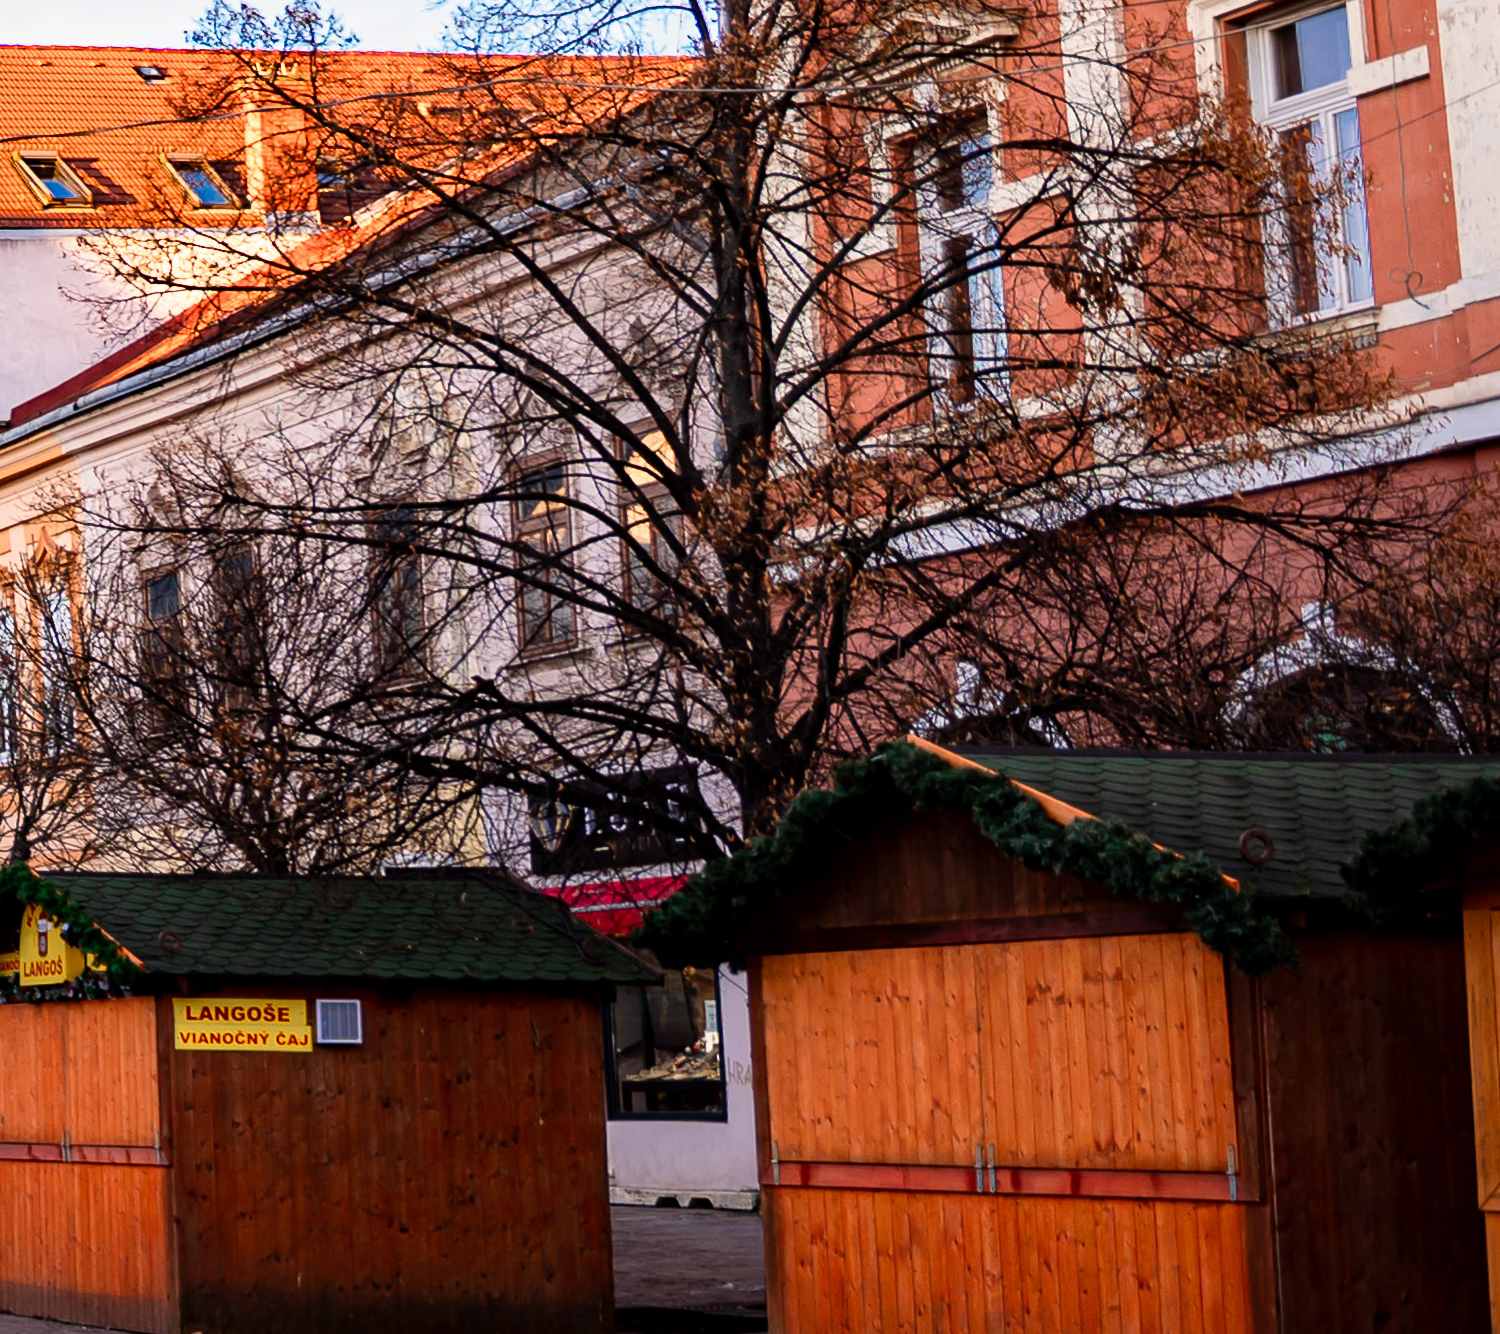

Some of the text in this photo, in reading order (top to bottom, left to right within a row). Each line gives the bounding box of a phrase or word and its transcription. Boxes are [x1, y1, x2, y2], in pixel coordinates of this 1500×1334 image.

[23, 954, 64, 978] LANGOŠ
[185, 1002, 290, 1022] LANGOŠE
[180, 1030, 309, 1046] VIANOČNÝ ČAJ
